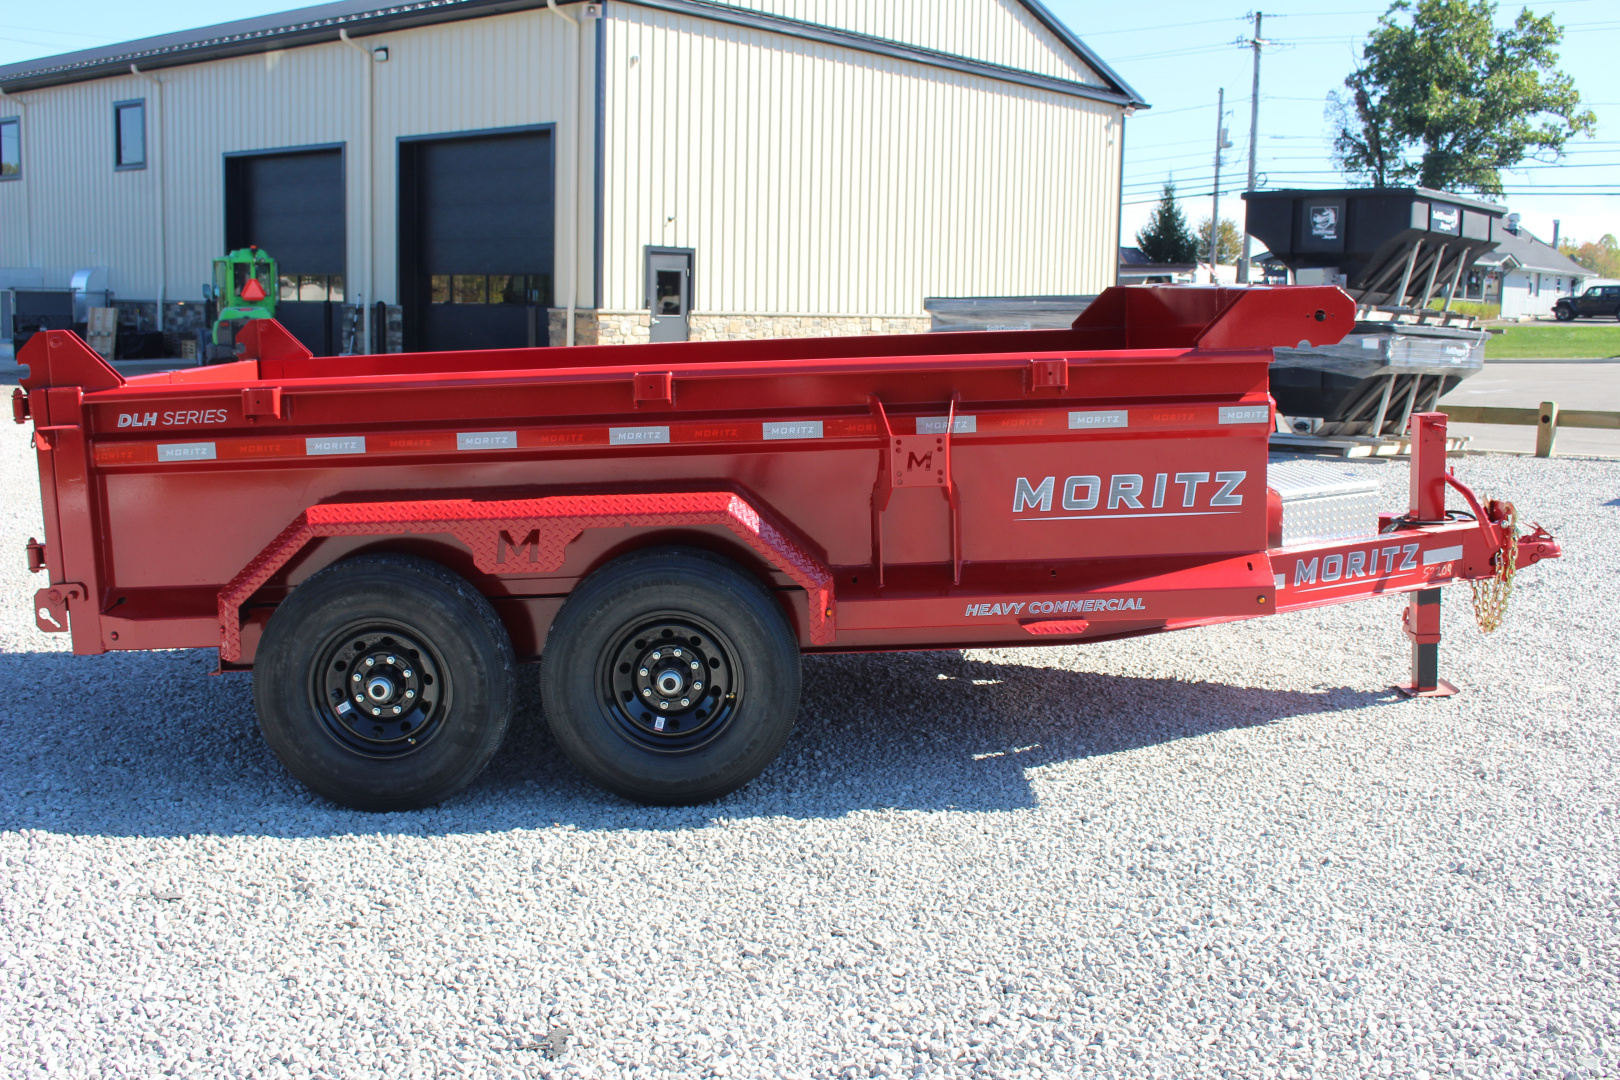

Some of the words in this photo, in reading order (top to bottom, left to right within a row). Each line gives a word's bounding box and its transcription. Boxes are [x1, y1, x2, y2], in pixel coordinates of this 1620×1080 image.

[118, 412, 157, 428] DLH
[162, 409, 227, 425] SERIES
[1077, 415, 1119, 424] MORITZ
[1153, 412, 1195, 422] MORITZ
[1227, 411, 1268, 419] MORITZ
[925, 421, 967, 430] MORTZ
[1001, 417, 1045, 427] MORITZ
[694, 428, 737, 438] MORITZ
[771, 426, 814, 435] MORITZ
[848, 424, 876, 432] MORI
[465, 436, 508, 445] MORITZ
[541, 433, 584, 443] MORITZ
[618, 431, 661, 440] MORITZ
[239, 443, 282, 453] MORITZ
[314, 441, 357, 451] MORITZ
[389, 438, 432, 448] MORITZ
[166, 447, 208, 457] MORITZ
[907, 451, 933, 471] M
[1013, 471, 1247, 512] MORITZ
[496, 529, 541, 564] M
[1293, 543, 1420, 587] MORITZ
[965, 602, 1025, 617] HEAVY
[1028, 598, 1145, 615] COMMERCIAL
